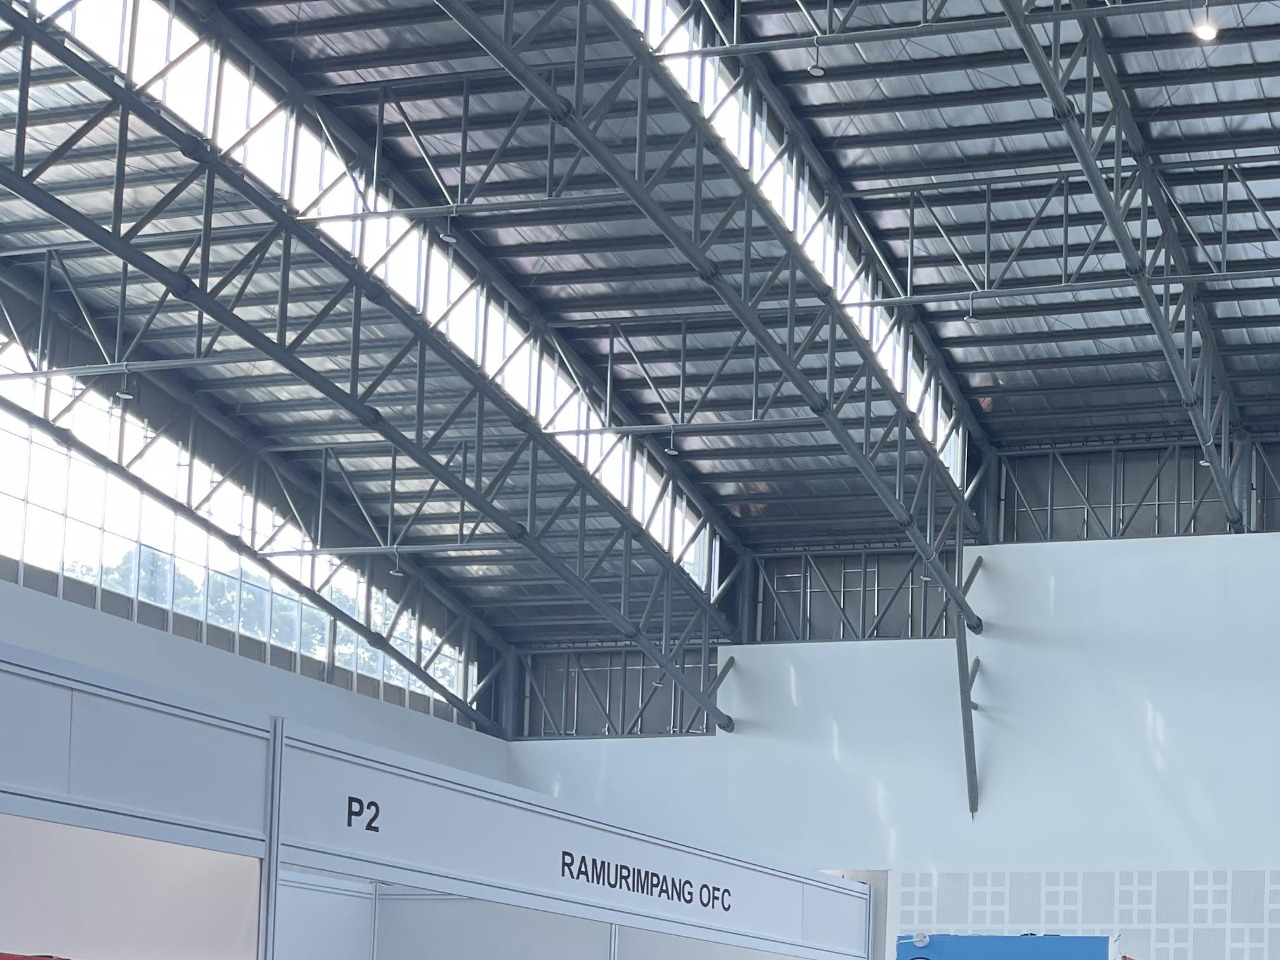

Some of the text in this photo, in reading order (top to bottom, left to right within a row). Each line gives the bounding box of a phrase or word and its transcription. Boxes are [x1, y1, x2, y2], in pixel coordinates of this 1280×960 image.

[346, 796, 380, 832] P2
[561, 850, 732, 912] RAMURIMPANG OFC
